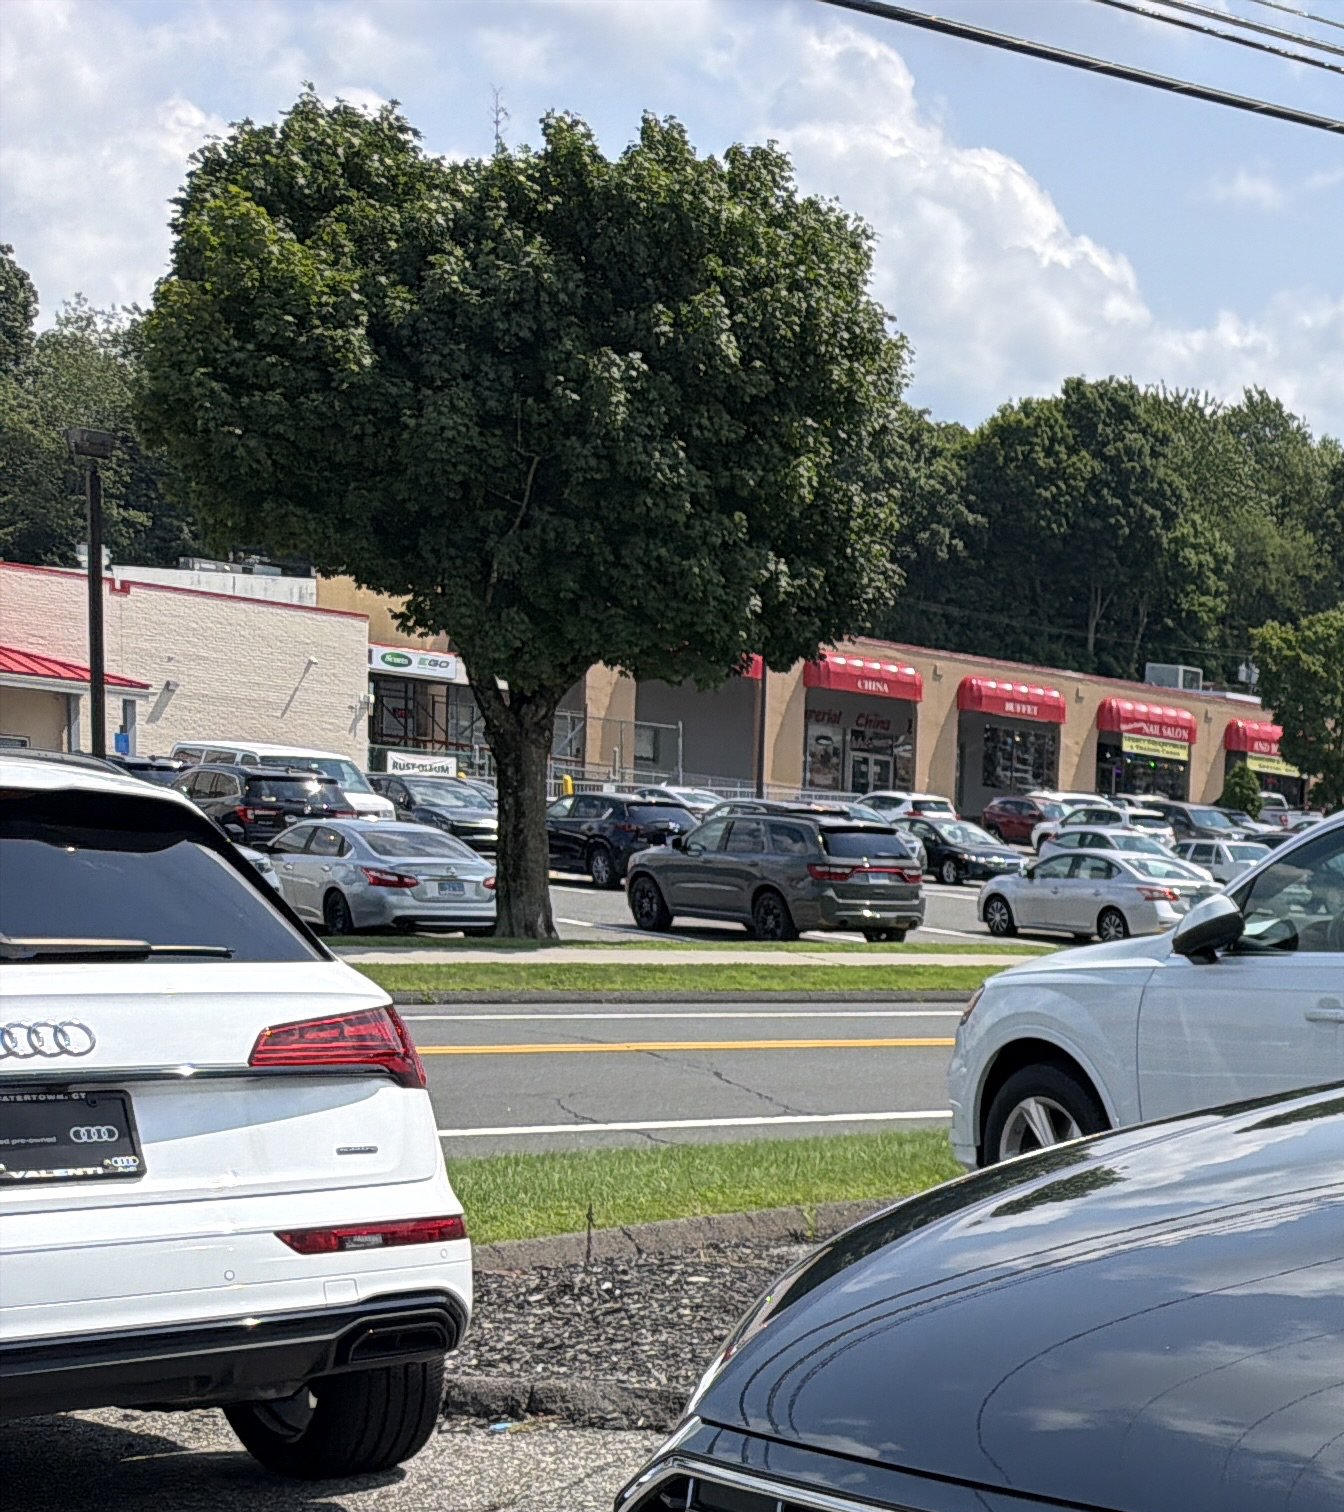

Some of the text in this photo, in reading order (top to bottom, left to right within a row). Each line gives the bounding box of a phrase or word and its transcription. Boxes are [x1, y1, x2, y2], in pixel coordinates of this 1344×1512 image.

[418, 658, 449, 668] EGO
[857, 679, 889, 693] CHINA
[1143, 723, 1161, 736] NAIL
[1161, 726, 1189, 739] SALON
[10, 1167, 103, 1178] VALENTI
